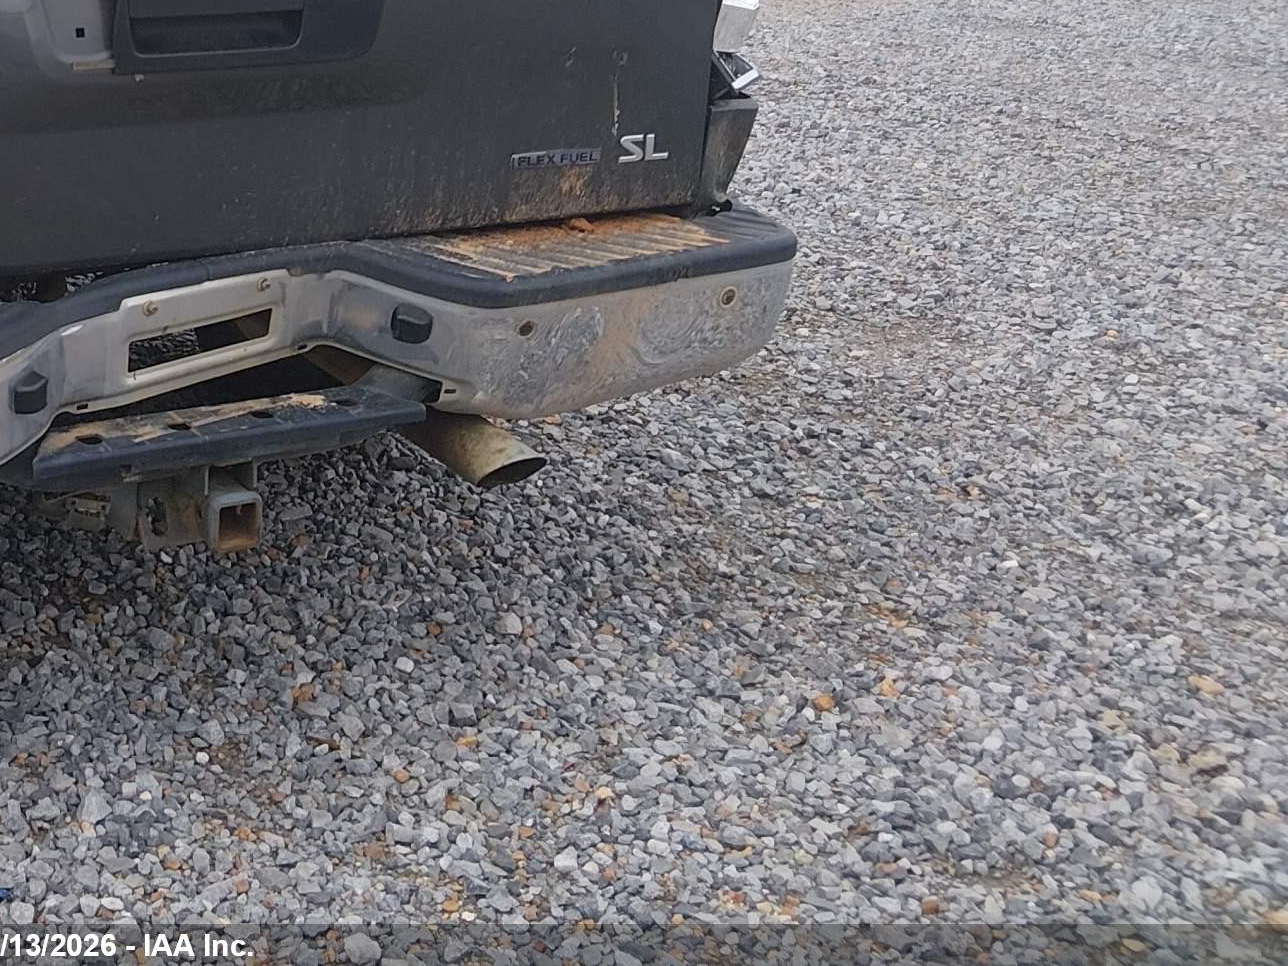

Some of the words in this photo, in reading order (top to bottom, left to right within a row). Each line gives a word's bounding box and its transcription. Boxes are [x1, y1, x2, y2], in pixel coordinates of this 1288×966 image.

[517, 154, 560, 168] FLEX
[560, 152, 598, 165] FUEL
[618, 133, 669, 164] SL
